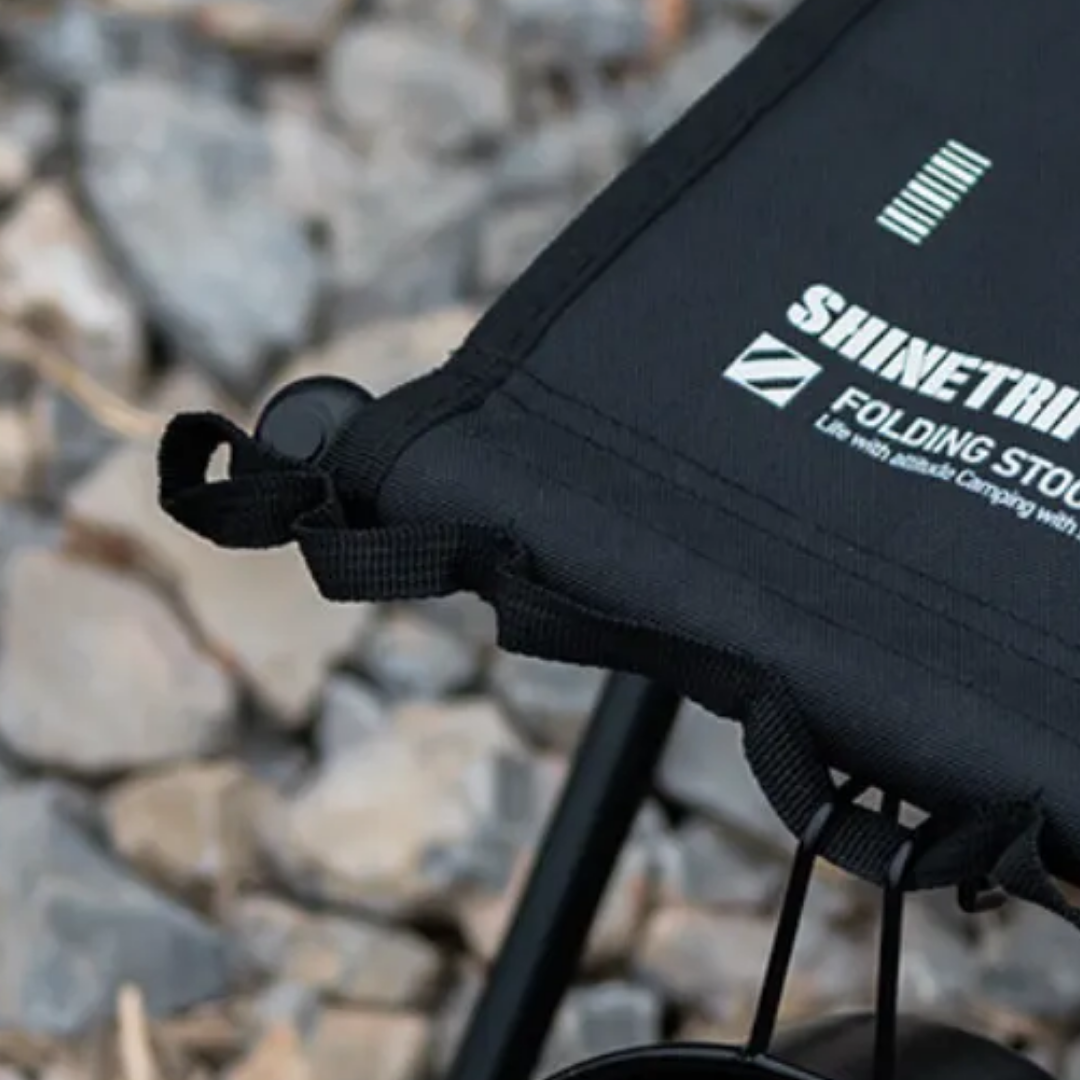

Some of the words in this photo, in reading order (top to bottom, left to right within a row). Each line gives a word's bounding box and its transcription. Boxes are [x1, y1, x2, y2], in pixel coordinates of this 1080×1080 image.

[814, 412, 851, 441] Life
[850, 431, 891, 462] with
[955, 469, 1038, 520] Camping
[1036, 505, 1078, 537] with
[829, 387, 994, 463] FOLDING
